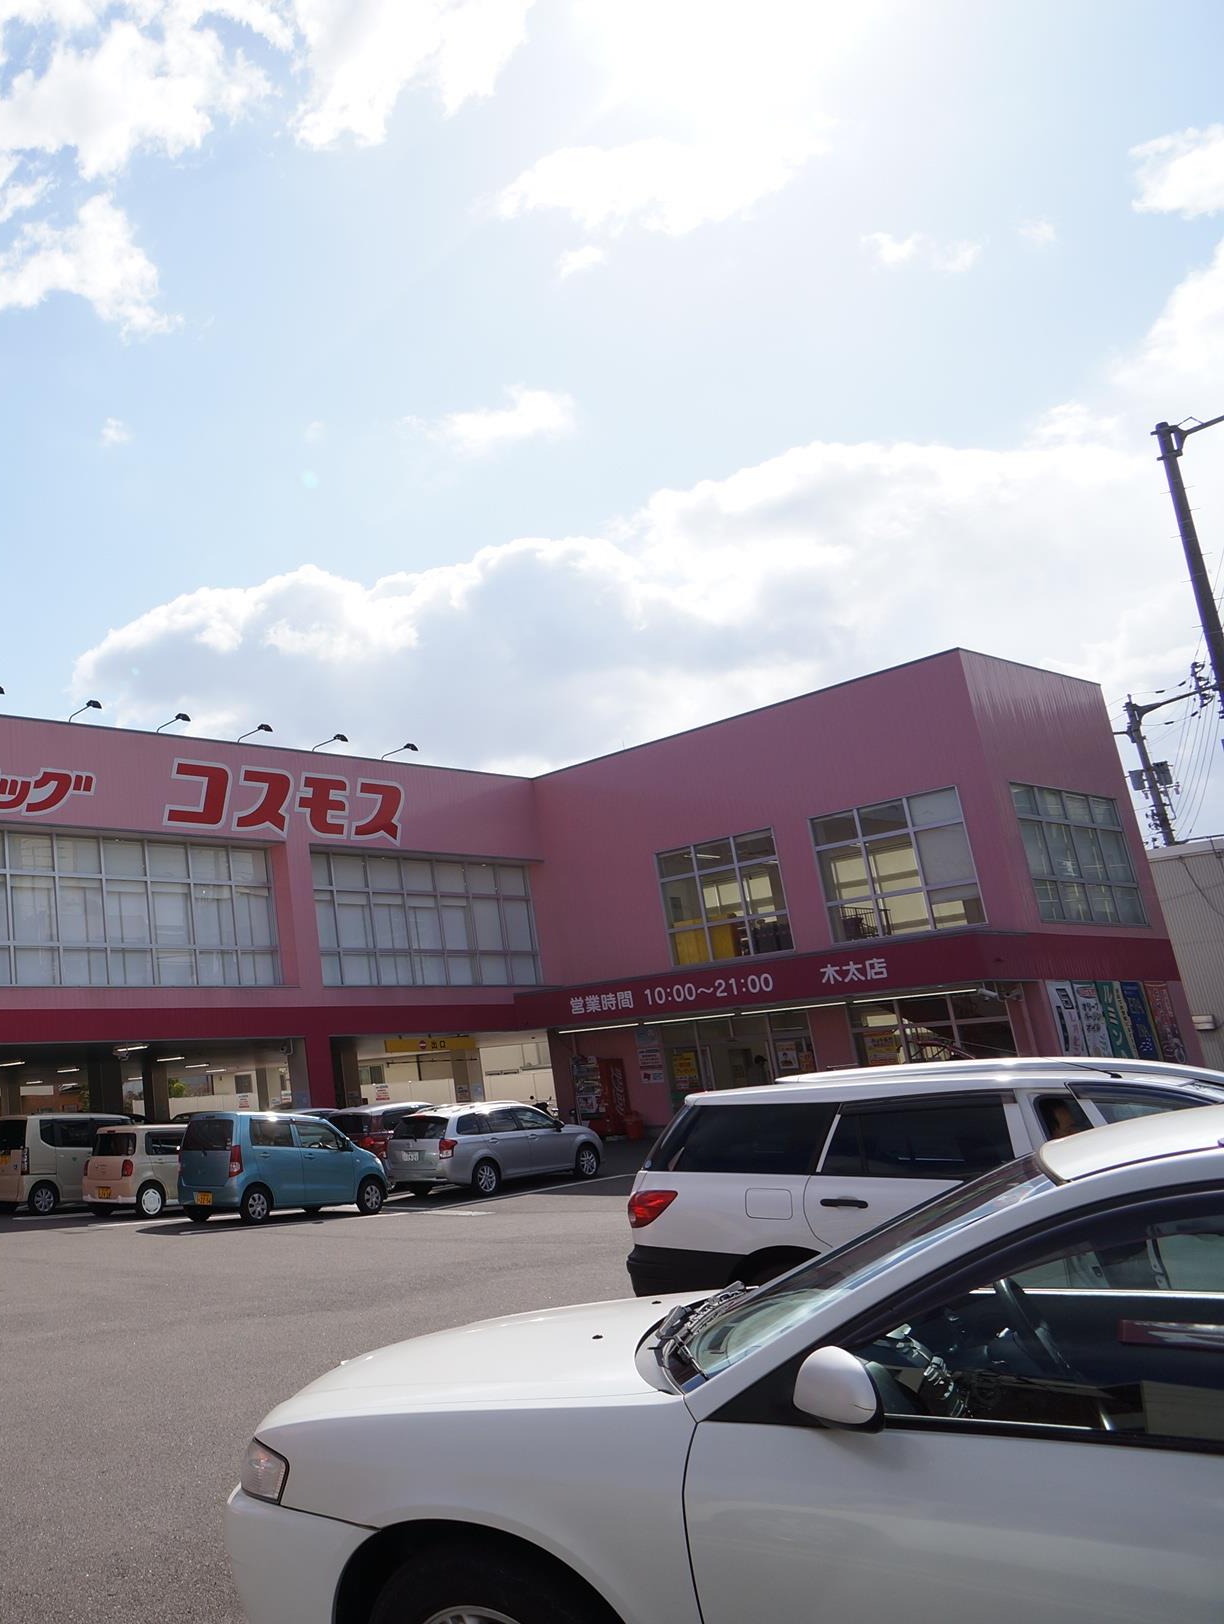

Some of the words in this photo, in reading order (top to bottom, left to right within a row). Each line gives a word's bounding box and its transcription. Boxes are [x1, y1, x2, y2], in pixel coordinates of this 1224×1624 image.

[163, 758, 405, 846] コスモス
[569, 990, 634, 1015] 営業時間
[819, 958, 888, 985] 木太店
[431, 1040, 446, 1049] 出口
